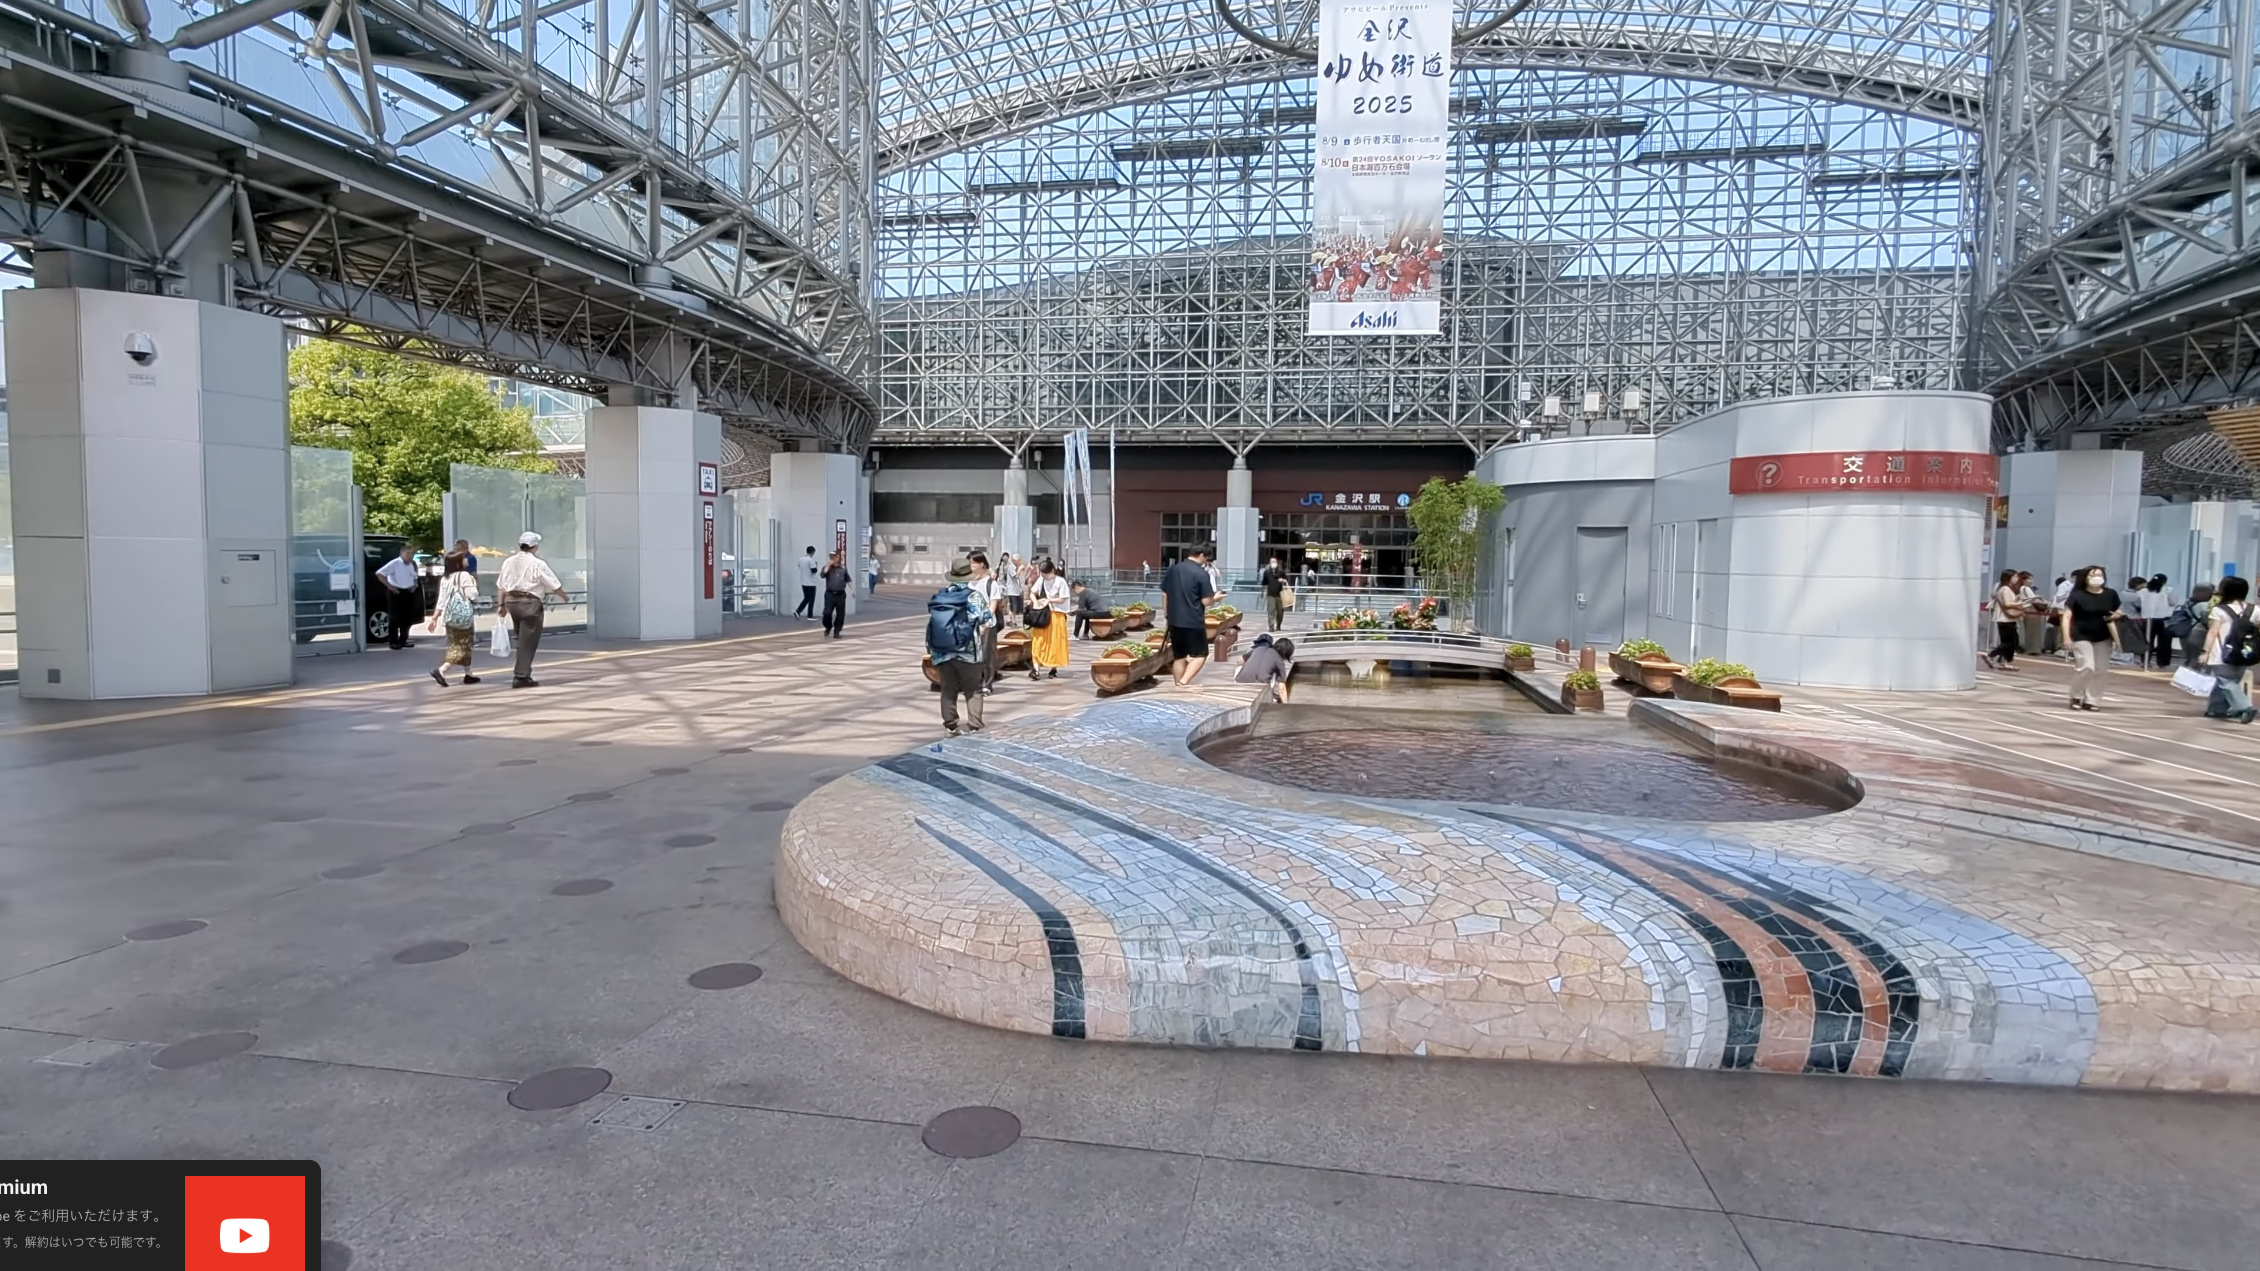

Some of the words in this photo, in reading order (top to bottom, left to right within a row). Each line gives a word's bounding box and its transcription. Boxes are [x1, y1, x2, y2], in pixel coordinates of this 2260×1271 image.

[1357, 17, 1412, 42] 金沢
[1323, 51, 1444, 84] ゆめ街道
[1353, 95, 1413, 115] 2025
[1322, 136, 1338, 146] 8/9
[1353, 135, 1401, 145] 歩行者天国
[1321, 158, 1341, 168] 8/10
[1350, 310, 1398, 328] Asahi
[702, 467, 715, 475] TAXI
[1798, 475, 1911, 486] Transportation
[1300, 493, 1324, 506] JR
[1335, 492, 1381, 504] 金沢駅
